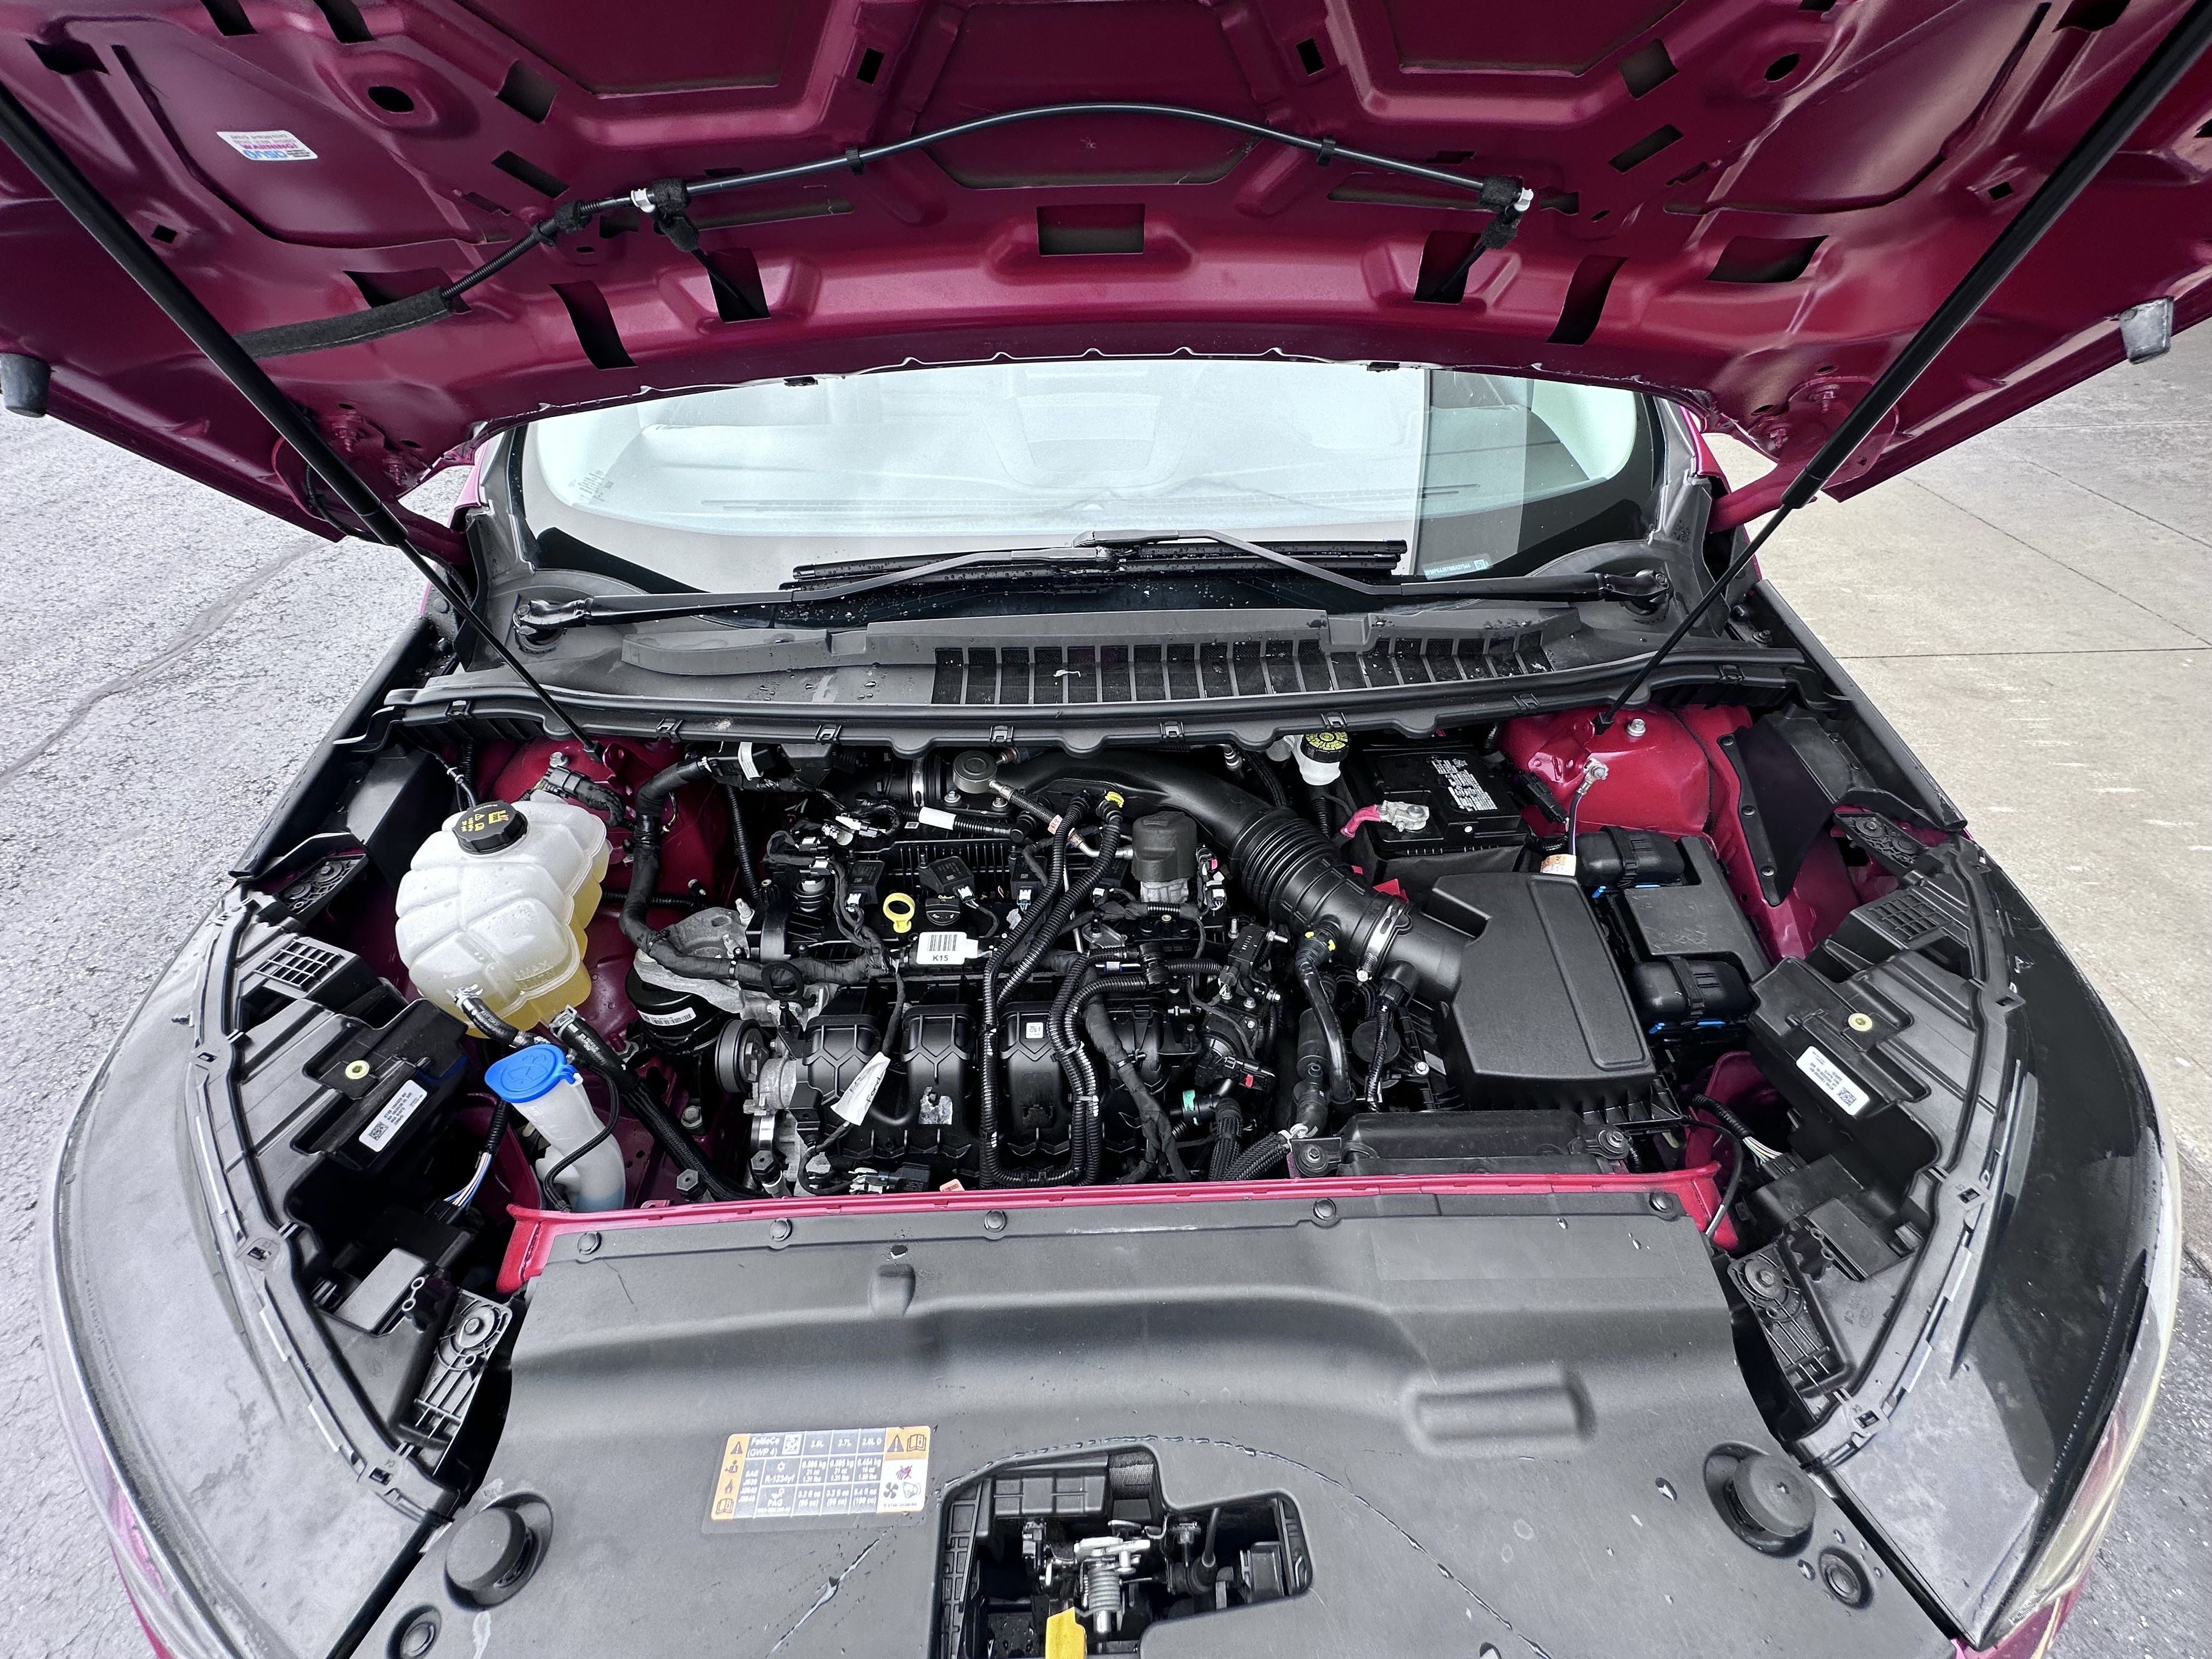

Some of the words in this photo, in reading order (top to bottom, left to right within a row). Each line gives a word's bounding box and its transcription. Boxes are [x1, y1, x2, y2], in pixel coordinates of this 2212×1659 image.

[867, 1077, 881, 1102] Ford
[747, 1448, 769, 1457] (GWP
[770, 1447, 777, 1457] 4)
[764, 1474, 795, 1484] R-1234yf
[767, 1499, 783, 1507] PAG
